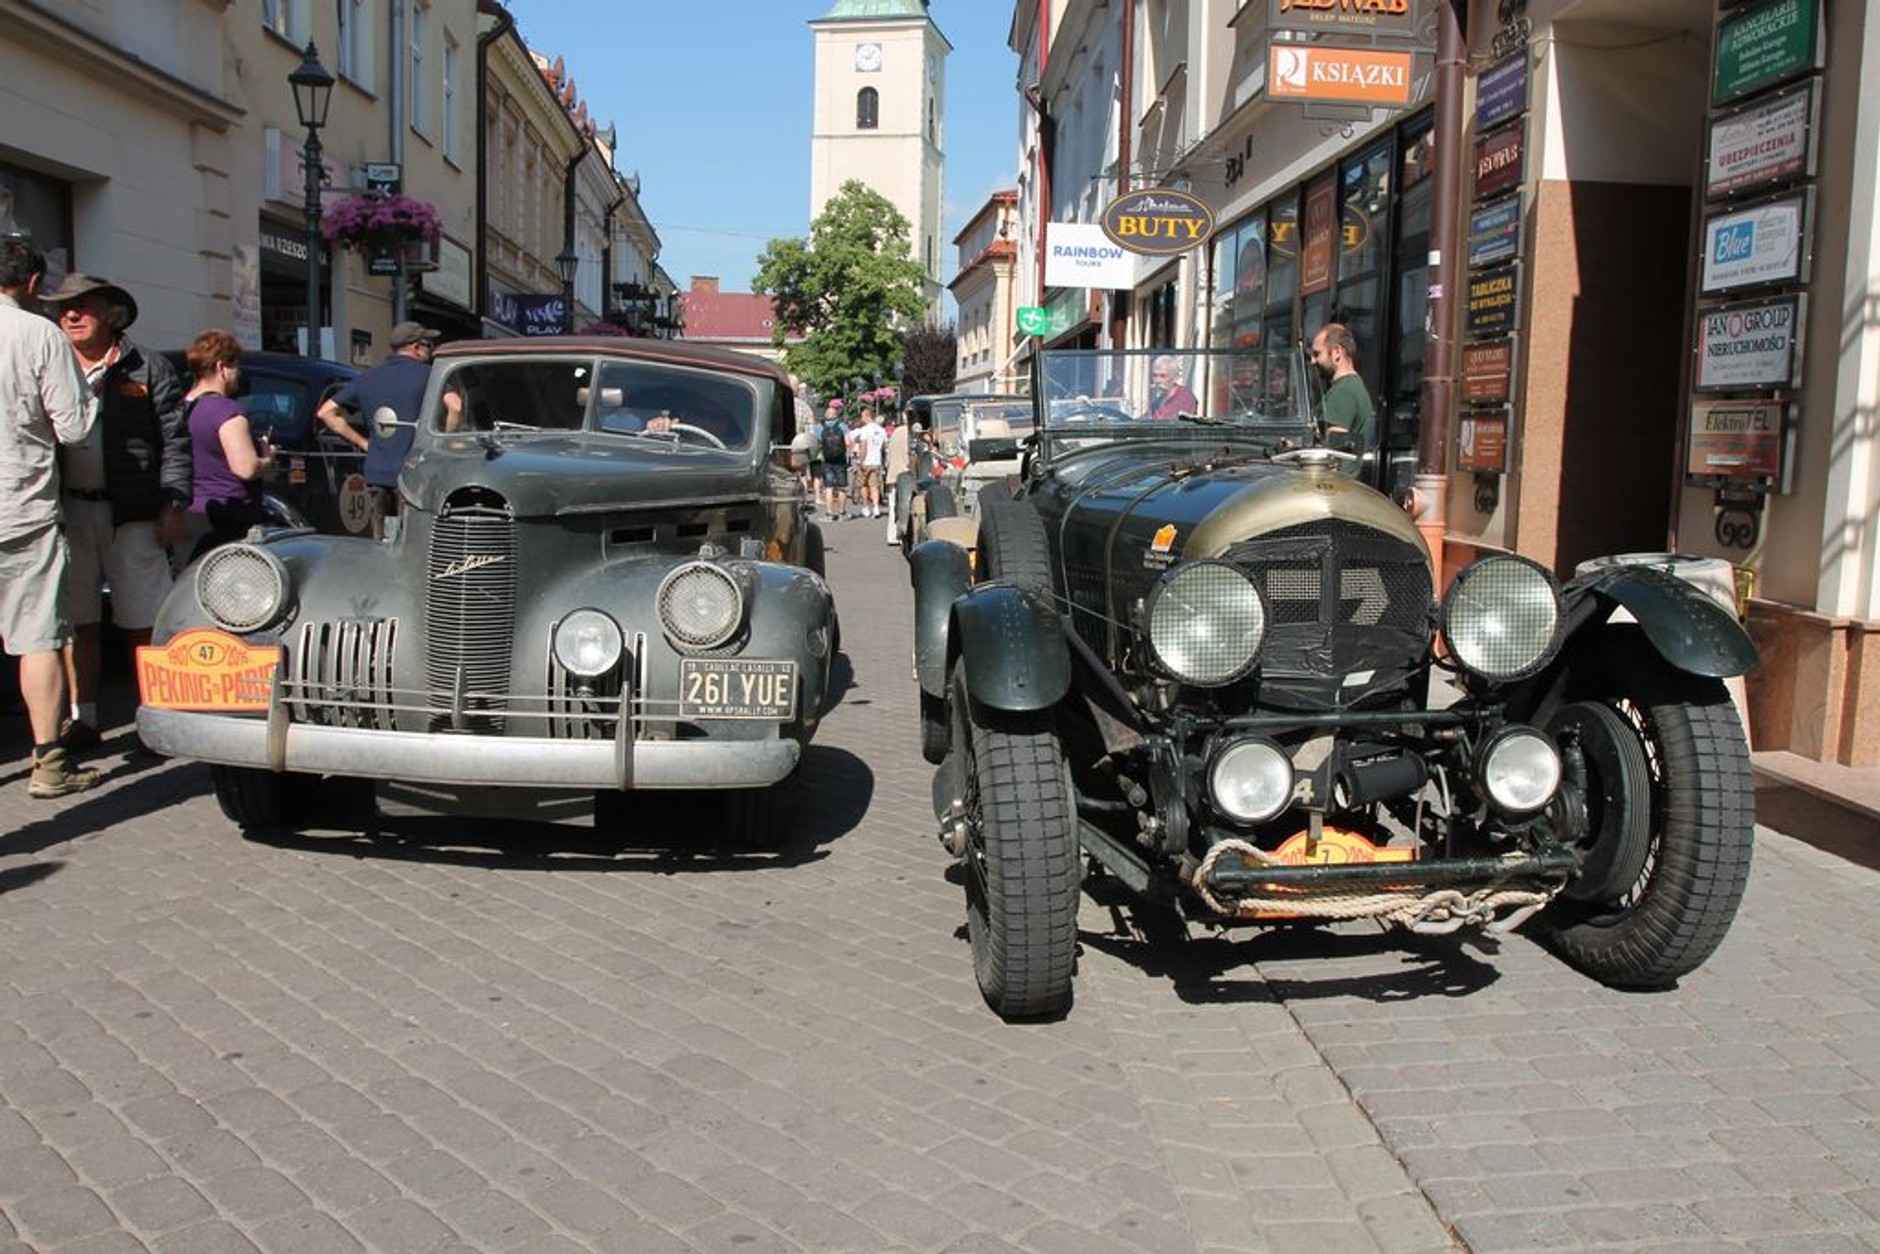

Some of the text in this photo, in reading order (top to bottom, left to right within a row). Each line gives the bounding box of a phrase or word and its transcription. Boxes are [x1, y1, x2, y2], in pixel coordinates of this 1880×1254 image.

[1119, 216, 1205, 238] BUTY
[1053, 245, 1124, 259] RAINBOW
[1717, 227, 1750, 261] Blue
[526, 326, 563, 335] PLAY
[348, 494, 365, 518] 49
[199, 646, 215, 661] 47
[143, 660, 212, 704] PEKING
[687, 673, 790, 706] 261 YUE
